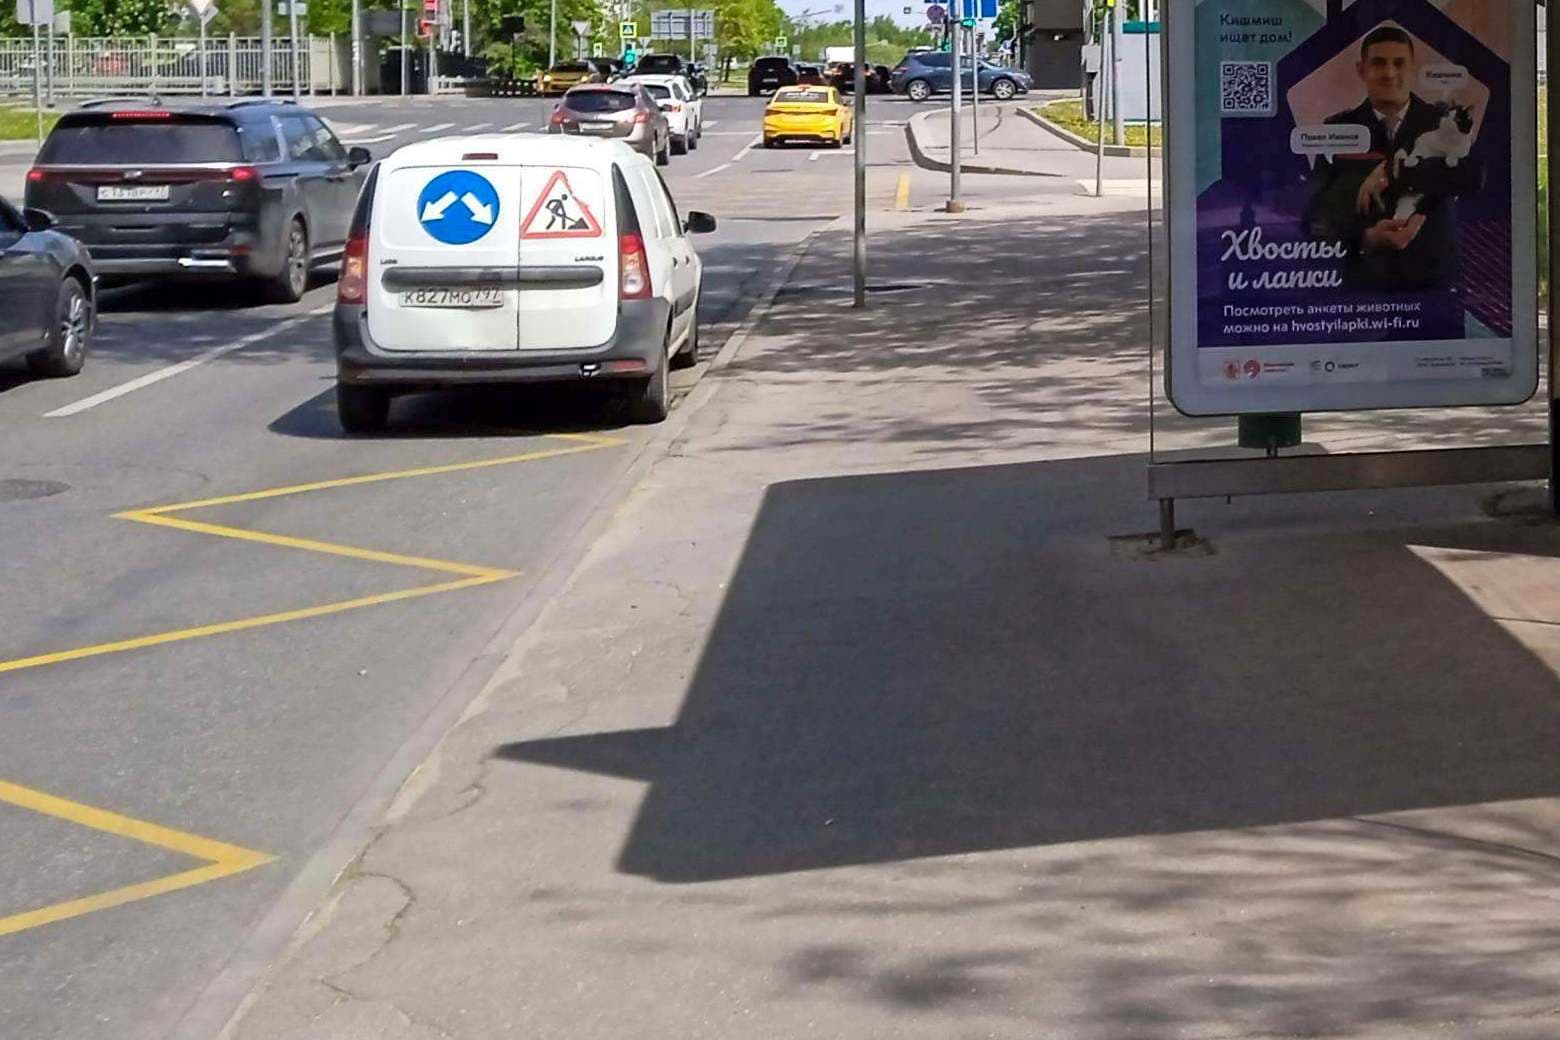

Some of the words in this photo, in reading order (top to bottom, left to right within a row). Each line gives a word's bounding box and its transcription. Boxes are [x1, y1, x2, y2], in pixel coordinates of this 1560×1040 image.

[1219, 13, 1283, 26] Кишмиш
[1219, 33, 1257, 44] ищет
[1258, 30, 1293, 45] дом!
[1220, 226, 1348, 262] Хвосты
[1227, 271, 1250, 291] и
[1252, 269, 1344, 290] лапки
[1223, 305, 1305, 318] Посмотреть
[1307, 304, 1354, 315] анкеты
[1356, 302, 1422, 314] животных
[1223, 323, 1271, 335] можно
[1273, 321, 1289, 334] на
[1291, 317, 1421, 334] hvostyilapki.wi-fi.ru
